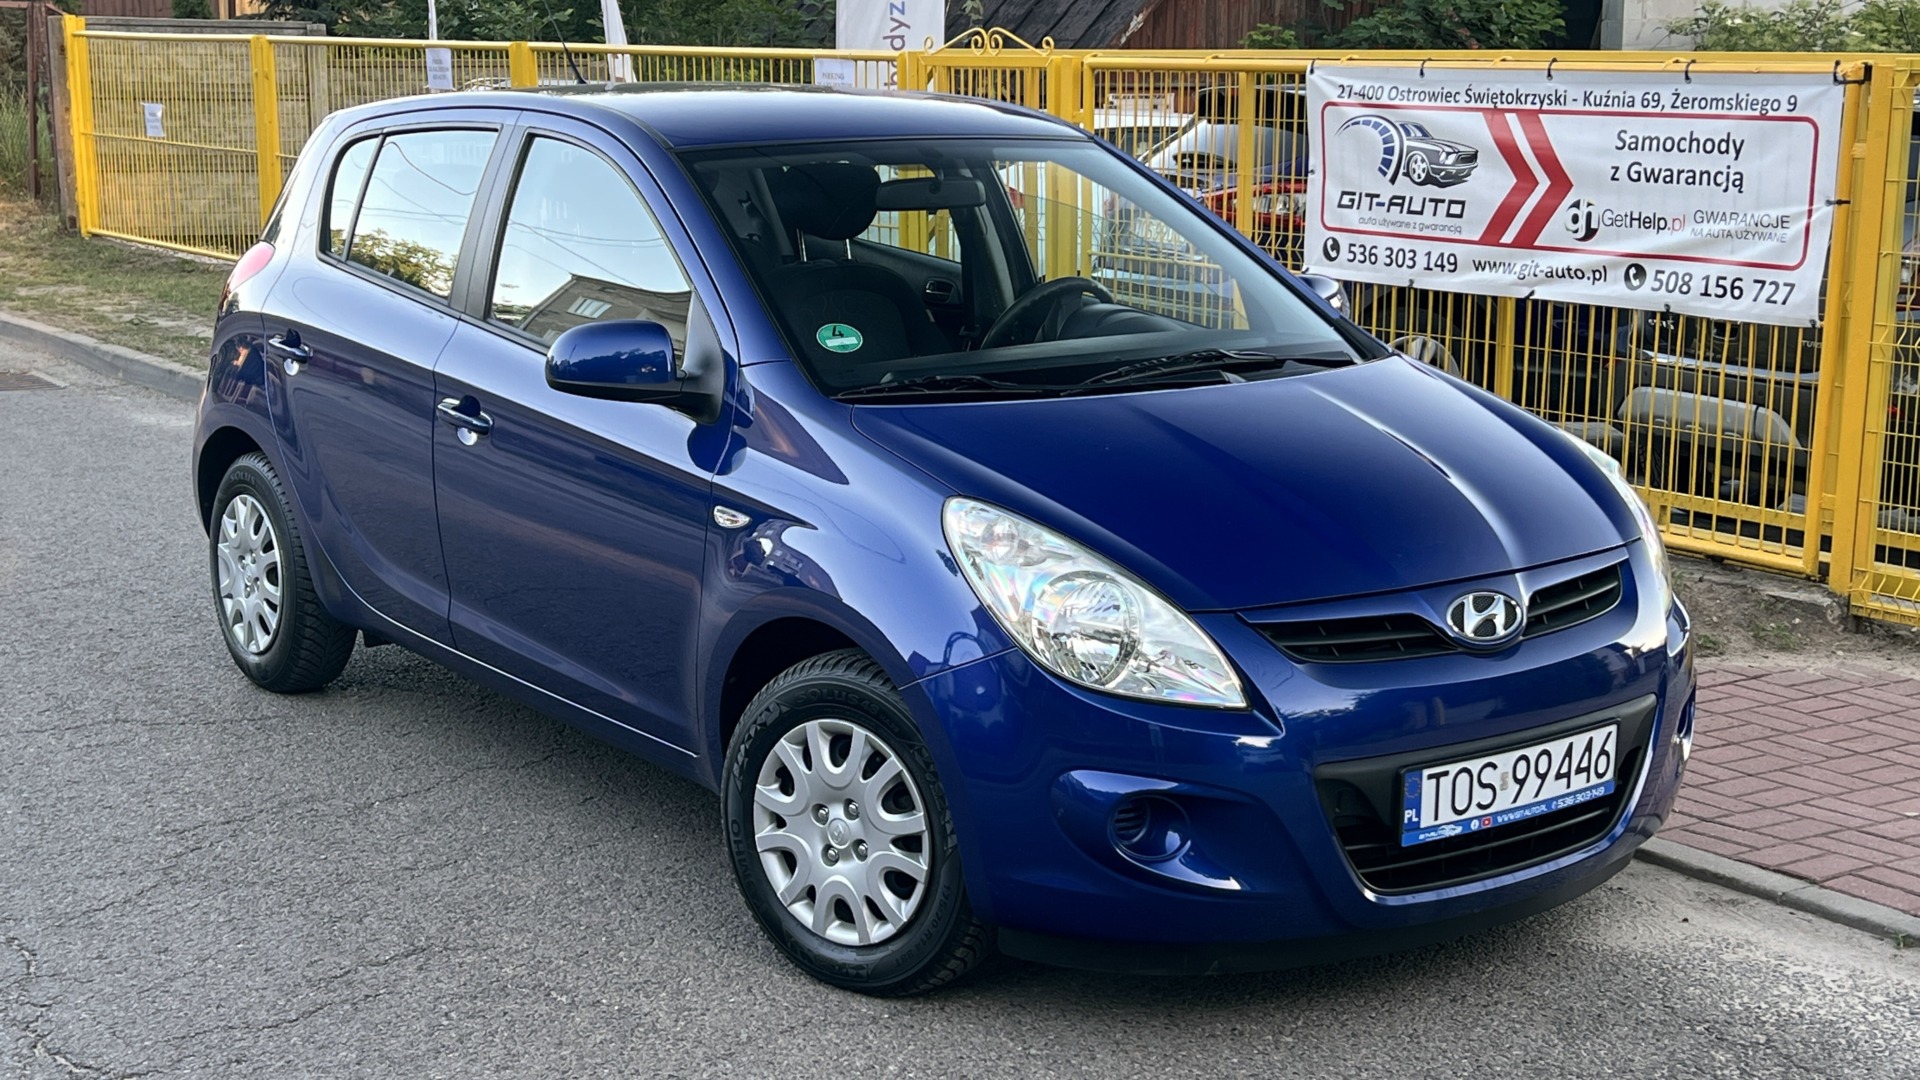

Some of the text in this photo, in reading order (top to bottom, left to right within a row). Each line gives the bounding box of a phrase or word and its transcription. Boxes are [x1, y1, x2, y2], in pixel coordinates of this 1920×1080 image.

[1337, 84, 1384, 101] 27-400
[1387, 85, 1461, 104] Ostrowiec
[1464, 83, 1567, 109] Świętokrzyski
[1583, 90, 1636, 108] Kuźnia
[1640, 91, 1665, 112] 69,
[1670, 88, 1781, 116] Żeromskiego
[1786, 94, 1798, 113] 9
[1615, 129, 1745, 161] Samochody
[1610, 161, 1744, 194] z Gwarancją
[1337, 190, 1467, 219] GIT-AUTO
[1693, 209, 1791, 229] GWARANCJE
[1601, 208, 1686, 236] GetHelp.pl
[1690, 228, 1788, 243] NA AUTA UŻYWANE
[1346, 243, 1458, 273] 536 303 149
[1472, 259, 1608, 285] www.git-auto.pl
[1650, 269, 1796, 306] 508 156 727
[832, 325, 844, 337] 4
[1426, 730, 1613, 822] TOS 99446
[1403, 808, 1419, 824] PL
